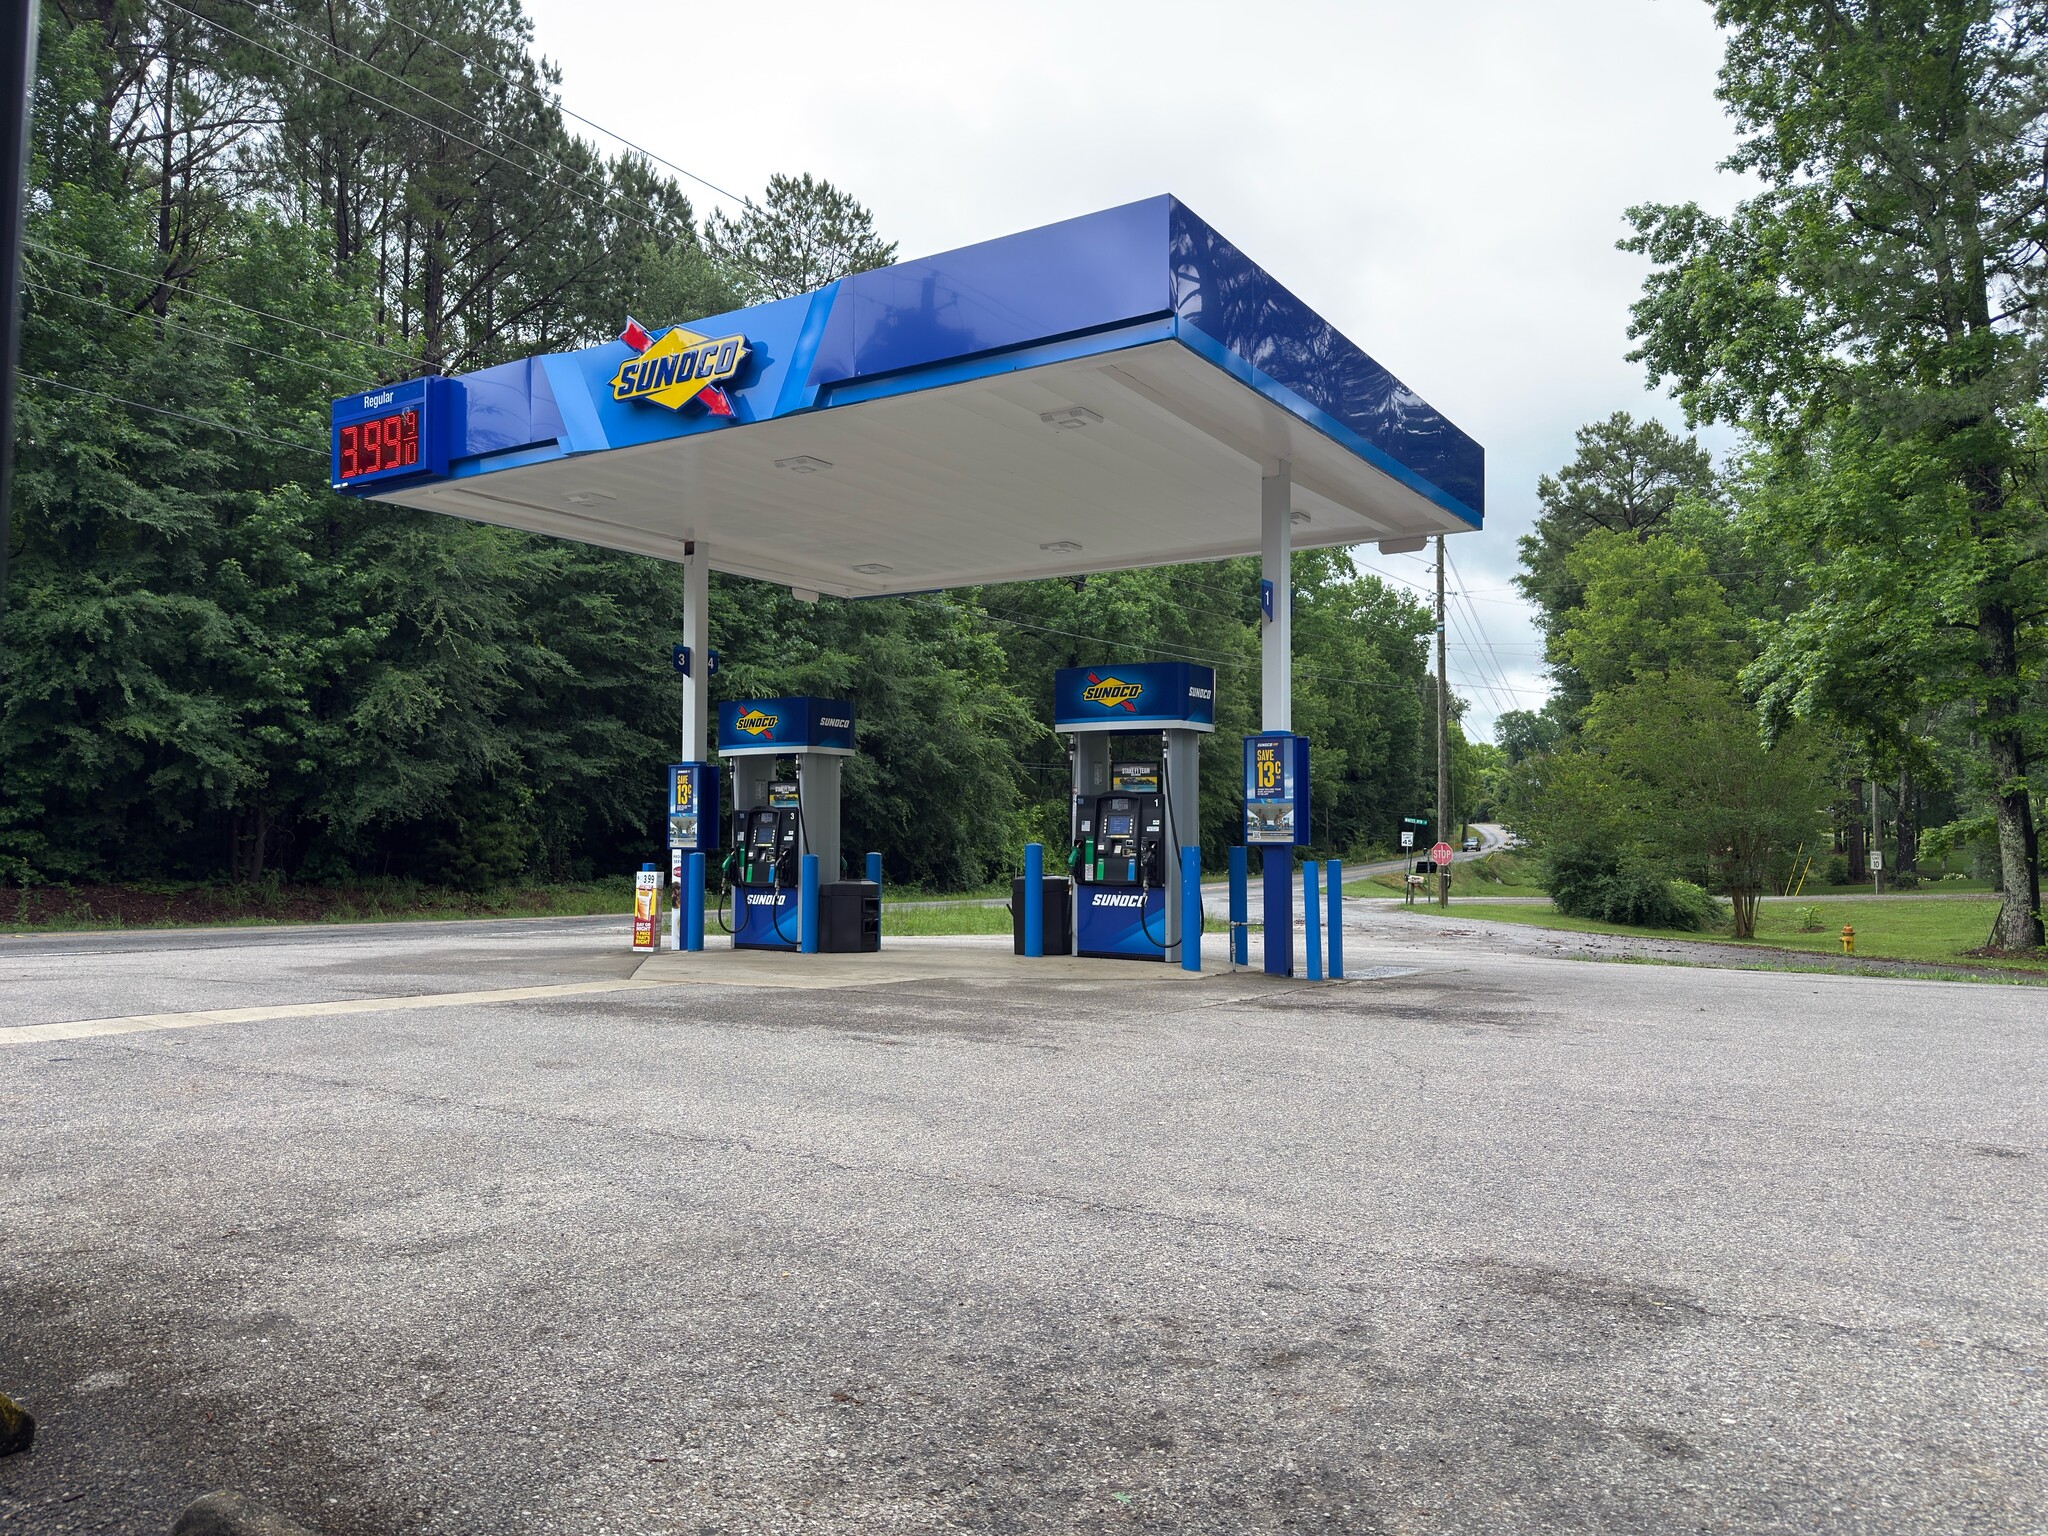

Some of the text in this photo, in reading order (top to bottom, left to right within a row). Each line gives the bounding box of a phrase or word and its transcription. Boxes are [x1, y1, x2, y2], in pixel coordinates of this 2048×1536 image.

[617, 340, 739, 396] SUNOCO
[364, 391, 394, 409] Regular
[342, 415, 401, 478] 3.99
[1265, 590, 1270, 605] 1
[678, 653, 685, 666] 3
[707, 657, 714, 669] 4
[1085, 685, 1139, 699] SUNOCO
[1188, 686, 1212, 700] SUNOCO
[737, 716, 777, 729] SUNOCO
[820, 717, 850, 729] SUNOCO
[1257, 749, 1274, 761] SAVE
[677, 775, 688, 784] SAVE
[1154, 799, 1159, 807] 1
[790, 812, 795, 820] 3
[1433, 849, 1451, 859] STOP
